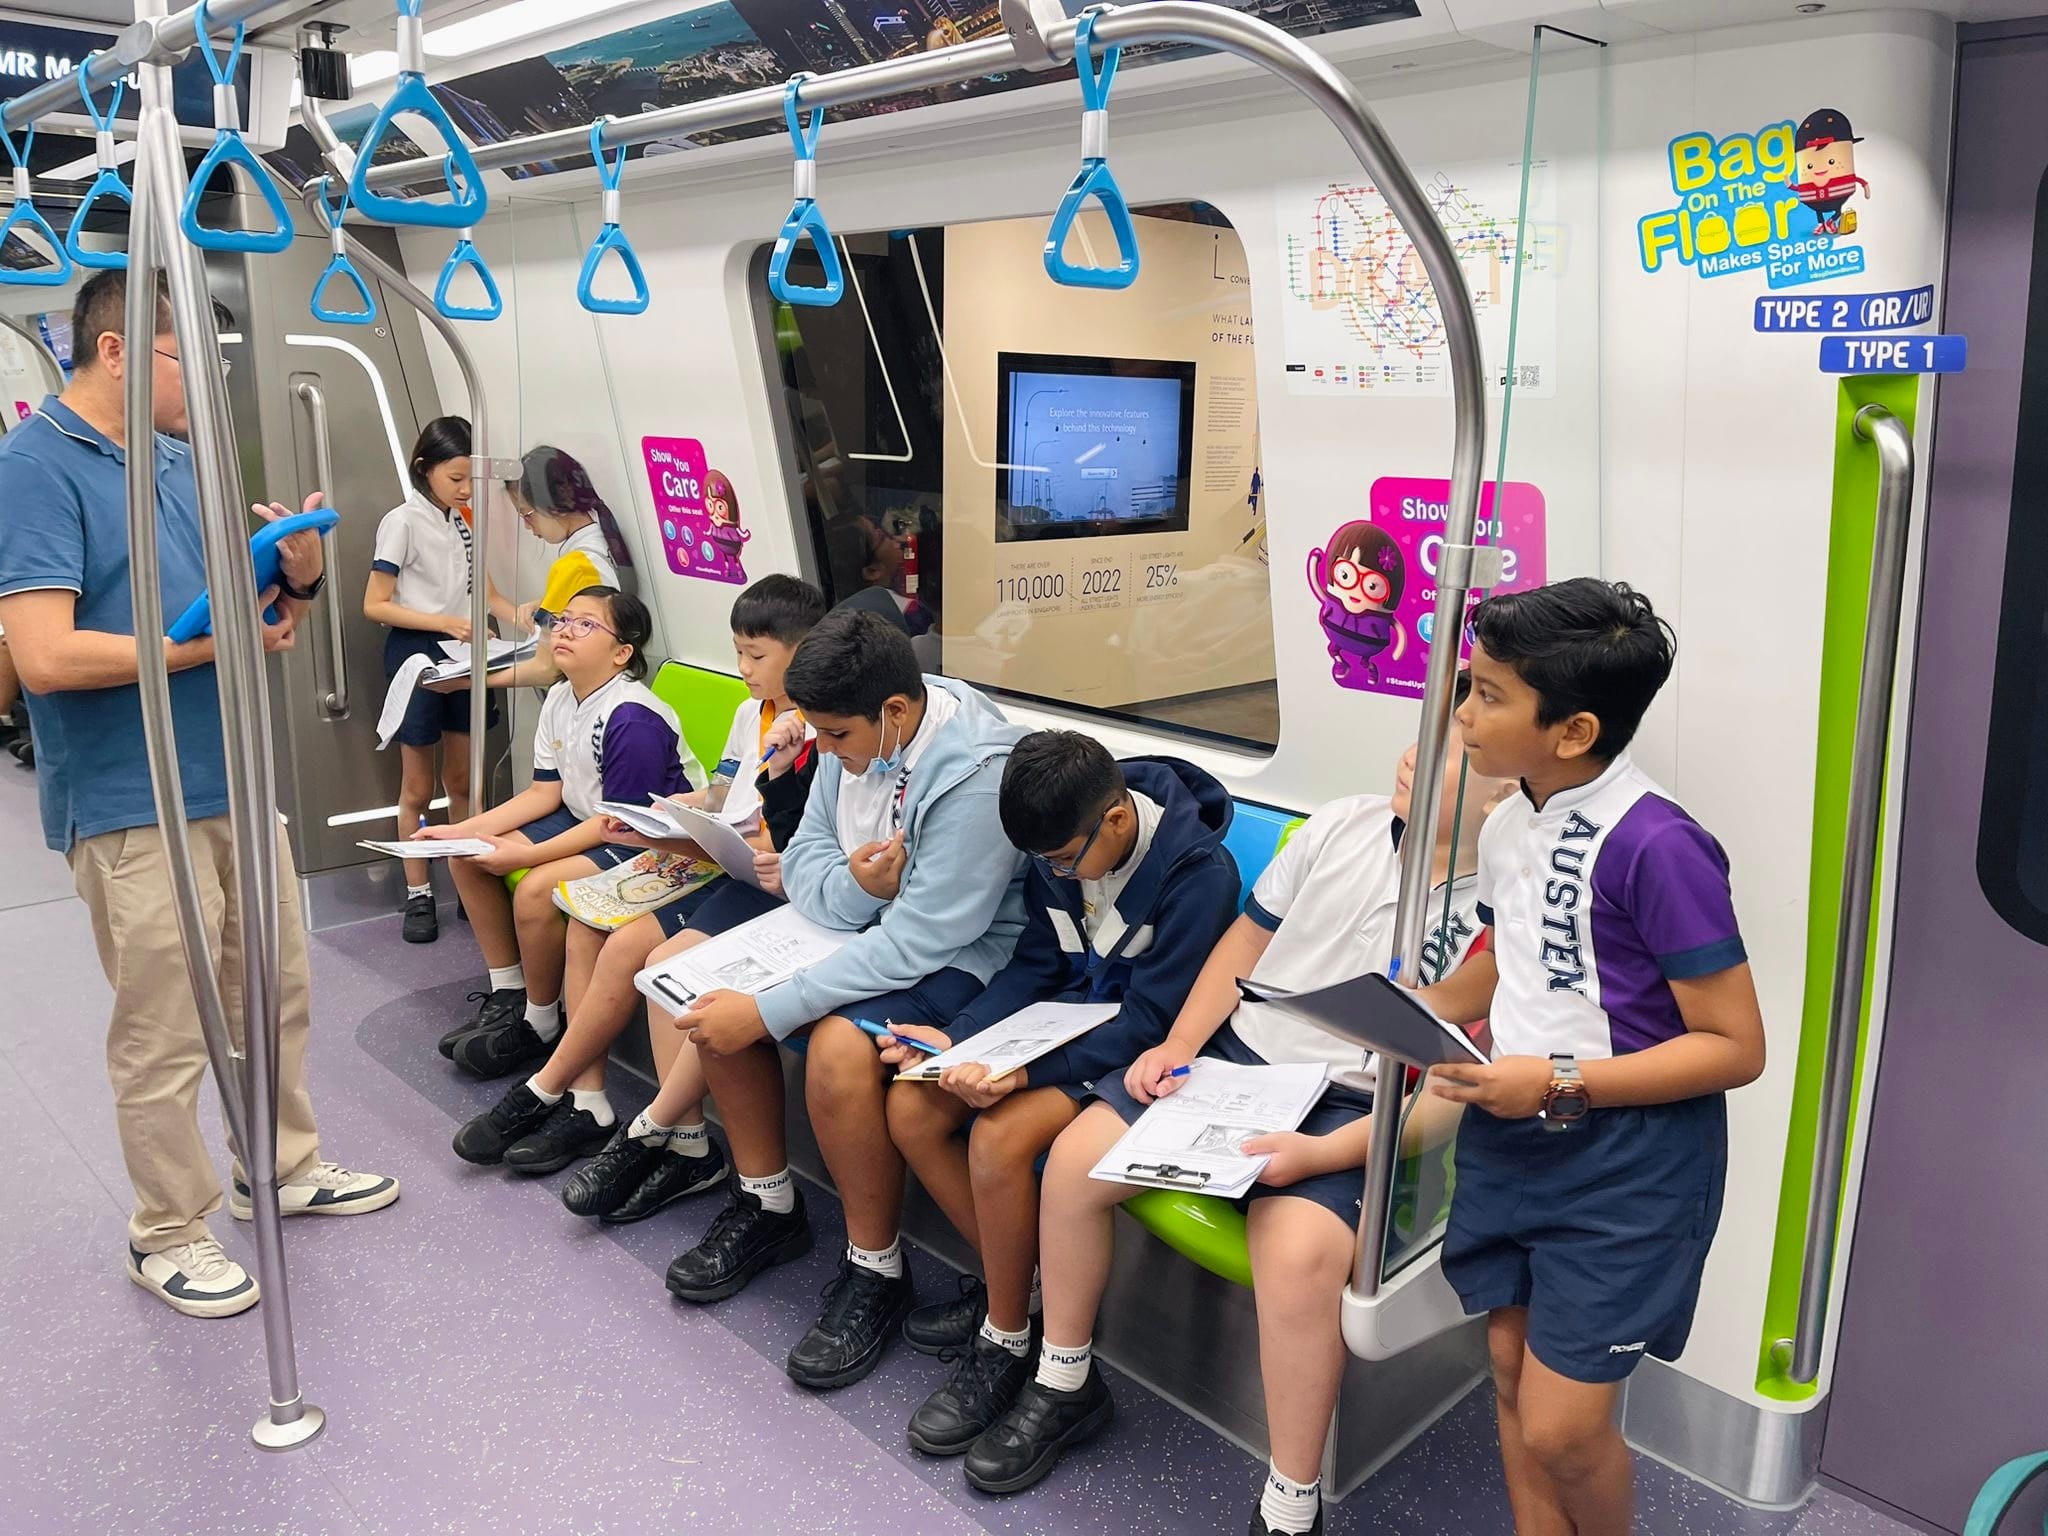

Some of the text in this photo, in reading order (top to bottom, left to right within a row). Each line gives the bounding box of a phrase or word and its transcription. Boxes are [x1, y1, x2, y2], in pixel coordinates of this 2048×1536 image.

[1672, 124, 1796, 192] Bag
[1687, 181, 1766, 212] On The
[1701, 237, 1829, 275] Makes Space
[1769, 250, 1860, 279] For More
[1212, 314, 1238, 324] WHAT
[1760, 300, 1822, 328] TYPE
[1831, 300, 1849, 328] 2
[1211, 332, 1224, 343] OF
[1227, 333, 1243, 344] THE
[1844, 341, 1935, 369] TYPE 1
[1049, 407, 1150, 419] Explore the innovative features
[1063, 423, 1137, 435] behind this technology
[651, 449, 672, 463] Show
[674, 458, 690, 472] You
[662, 470, 700, 499] Care
[1475, 519, 1503, 538] ou
[1419, 534, 1518, 583] Ce
[996, 574, 1064, 603] 110,000
[1082, 568, 1121, 595] 2022
[1146, 563, 1178, 589] 25%
[1539, 809, 1605, 997] AUSTEN
